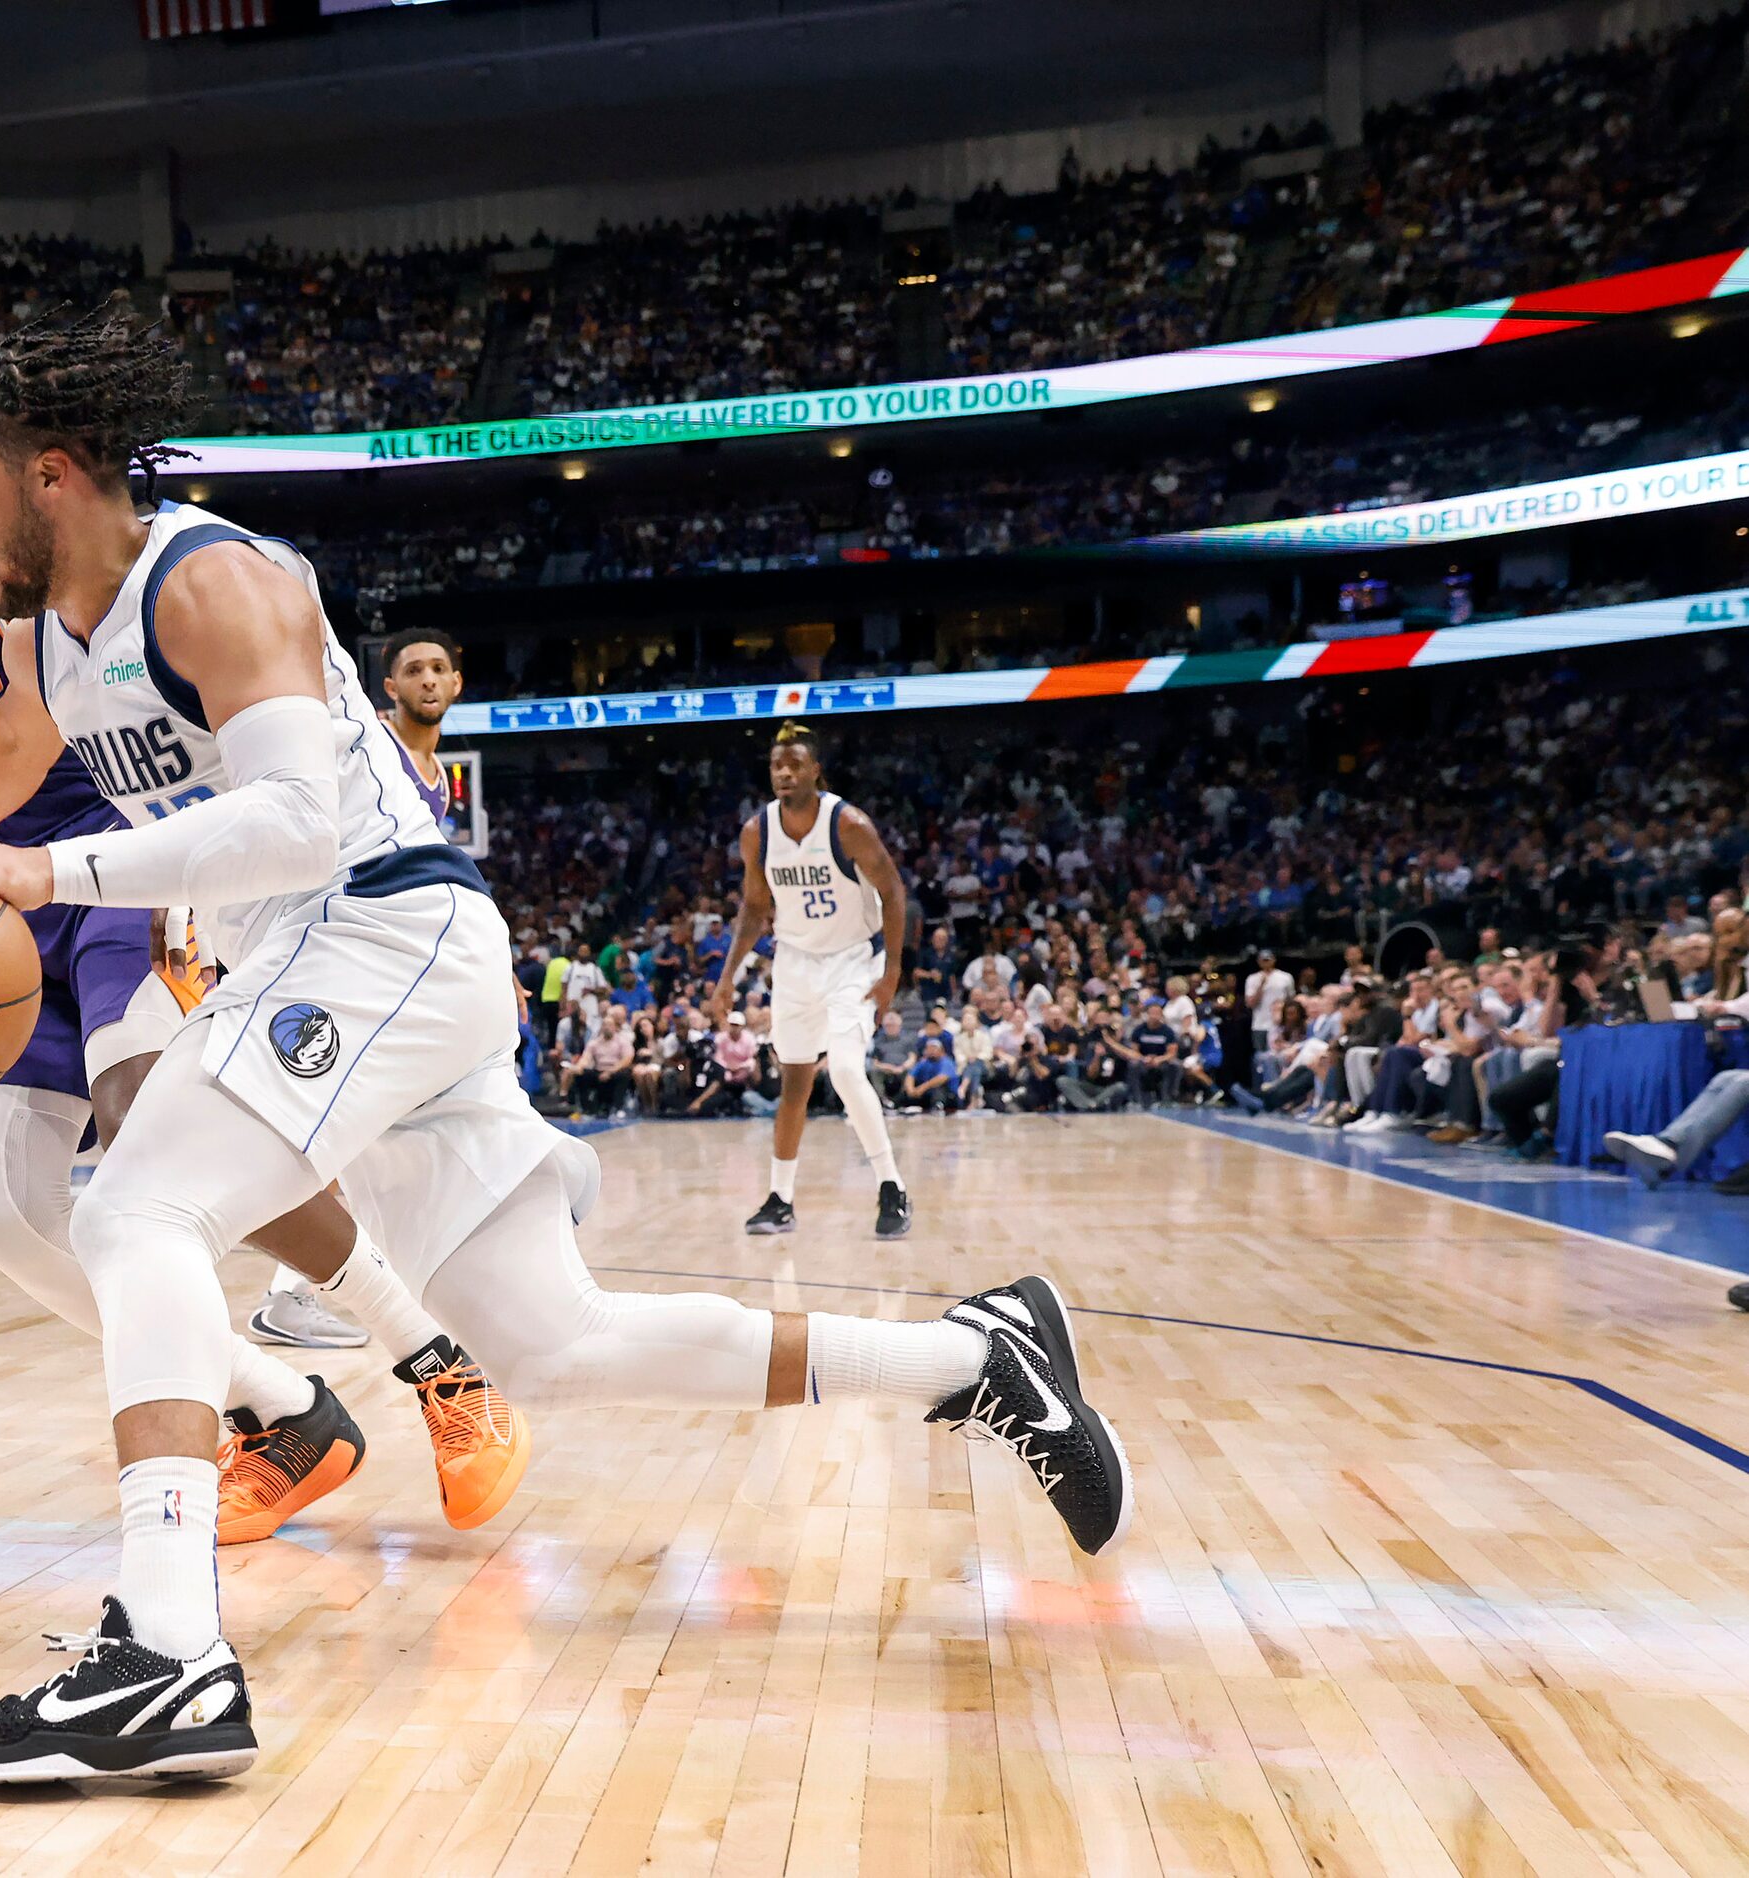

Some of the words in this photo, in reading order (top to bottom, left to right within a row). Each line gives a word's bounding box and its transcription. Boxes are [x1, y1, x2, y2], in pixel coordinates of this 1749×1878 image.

[369, 434, 421, 461] ALL
[426, 429, 482, 456] THE
[489, 413, 637, 451] CLASSICS
[644, 398, 810, 440] DELIVERED
[818, 395, 857, 422] TO
[868, 387, 950, 417] YOUR
[960, 378, 1050, 409] DOOR
[1418, 491, 1581, 536] DELIVERED
[1590, 482, 1629, 509] TO
[1641, 467, 1725, 500] YOUR
[1686, 599, 1735, 625] ALL
[103, 659, 146, 685] chime
[67, 713, 194, 797] ALLAS
[771, 865, 832, 887] DALLAS
[802, 888, 837, 919] 25
[190, 1699, 205, 1724] 2
